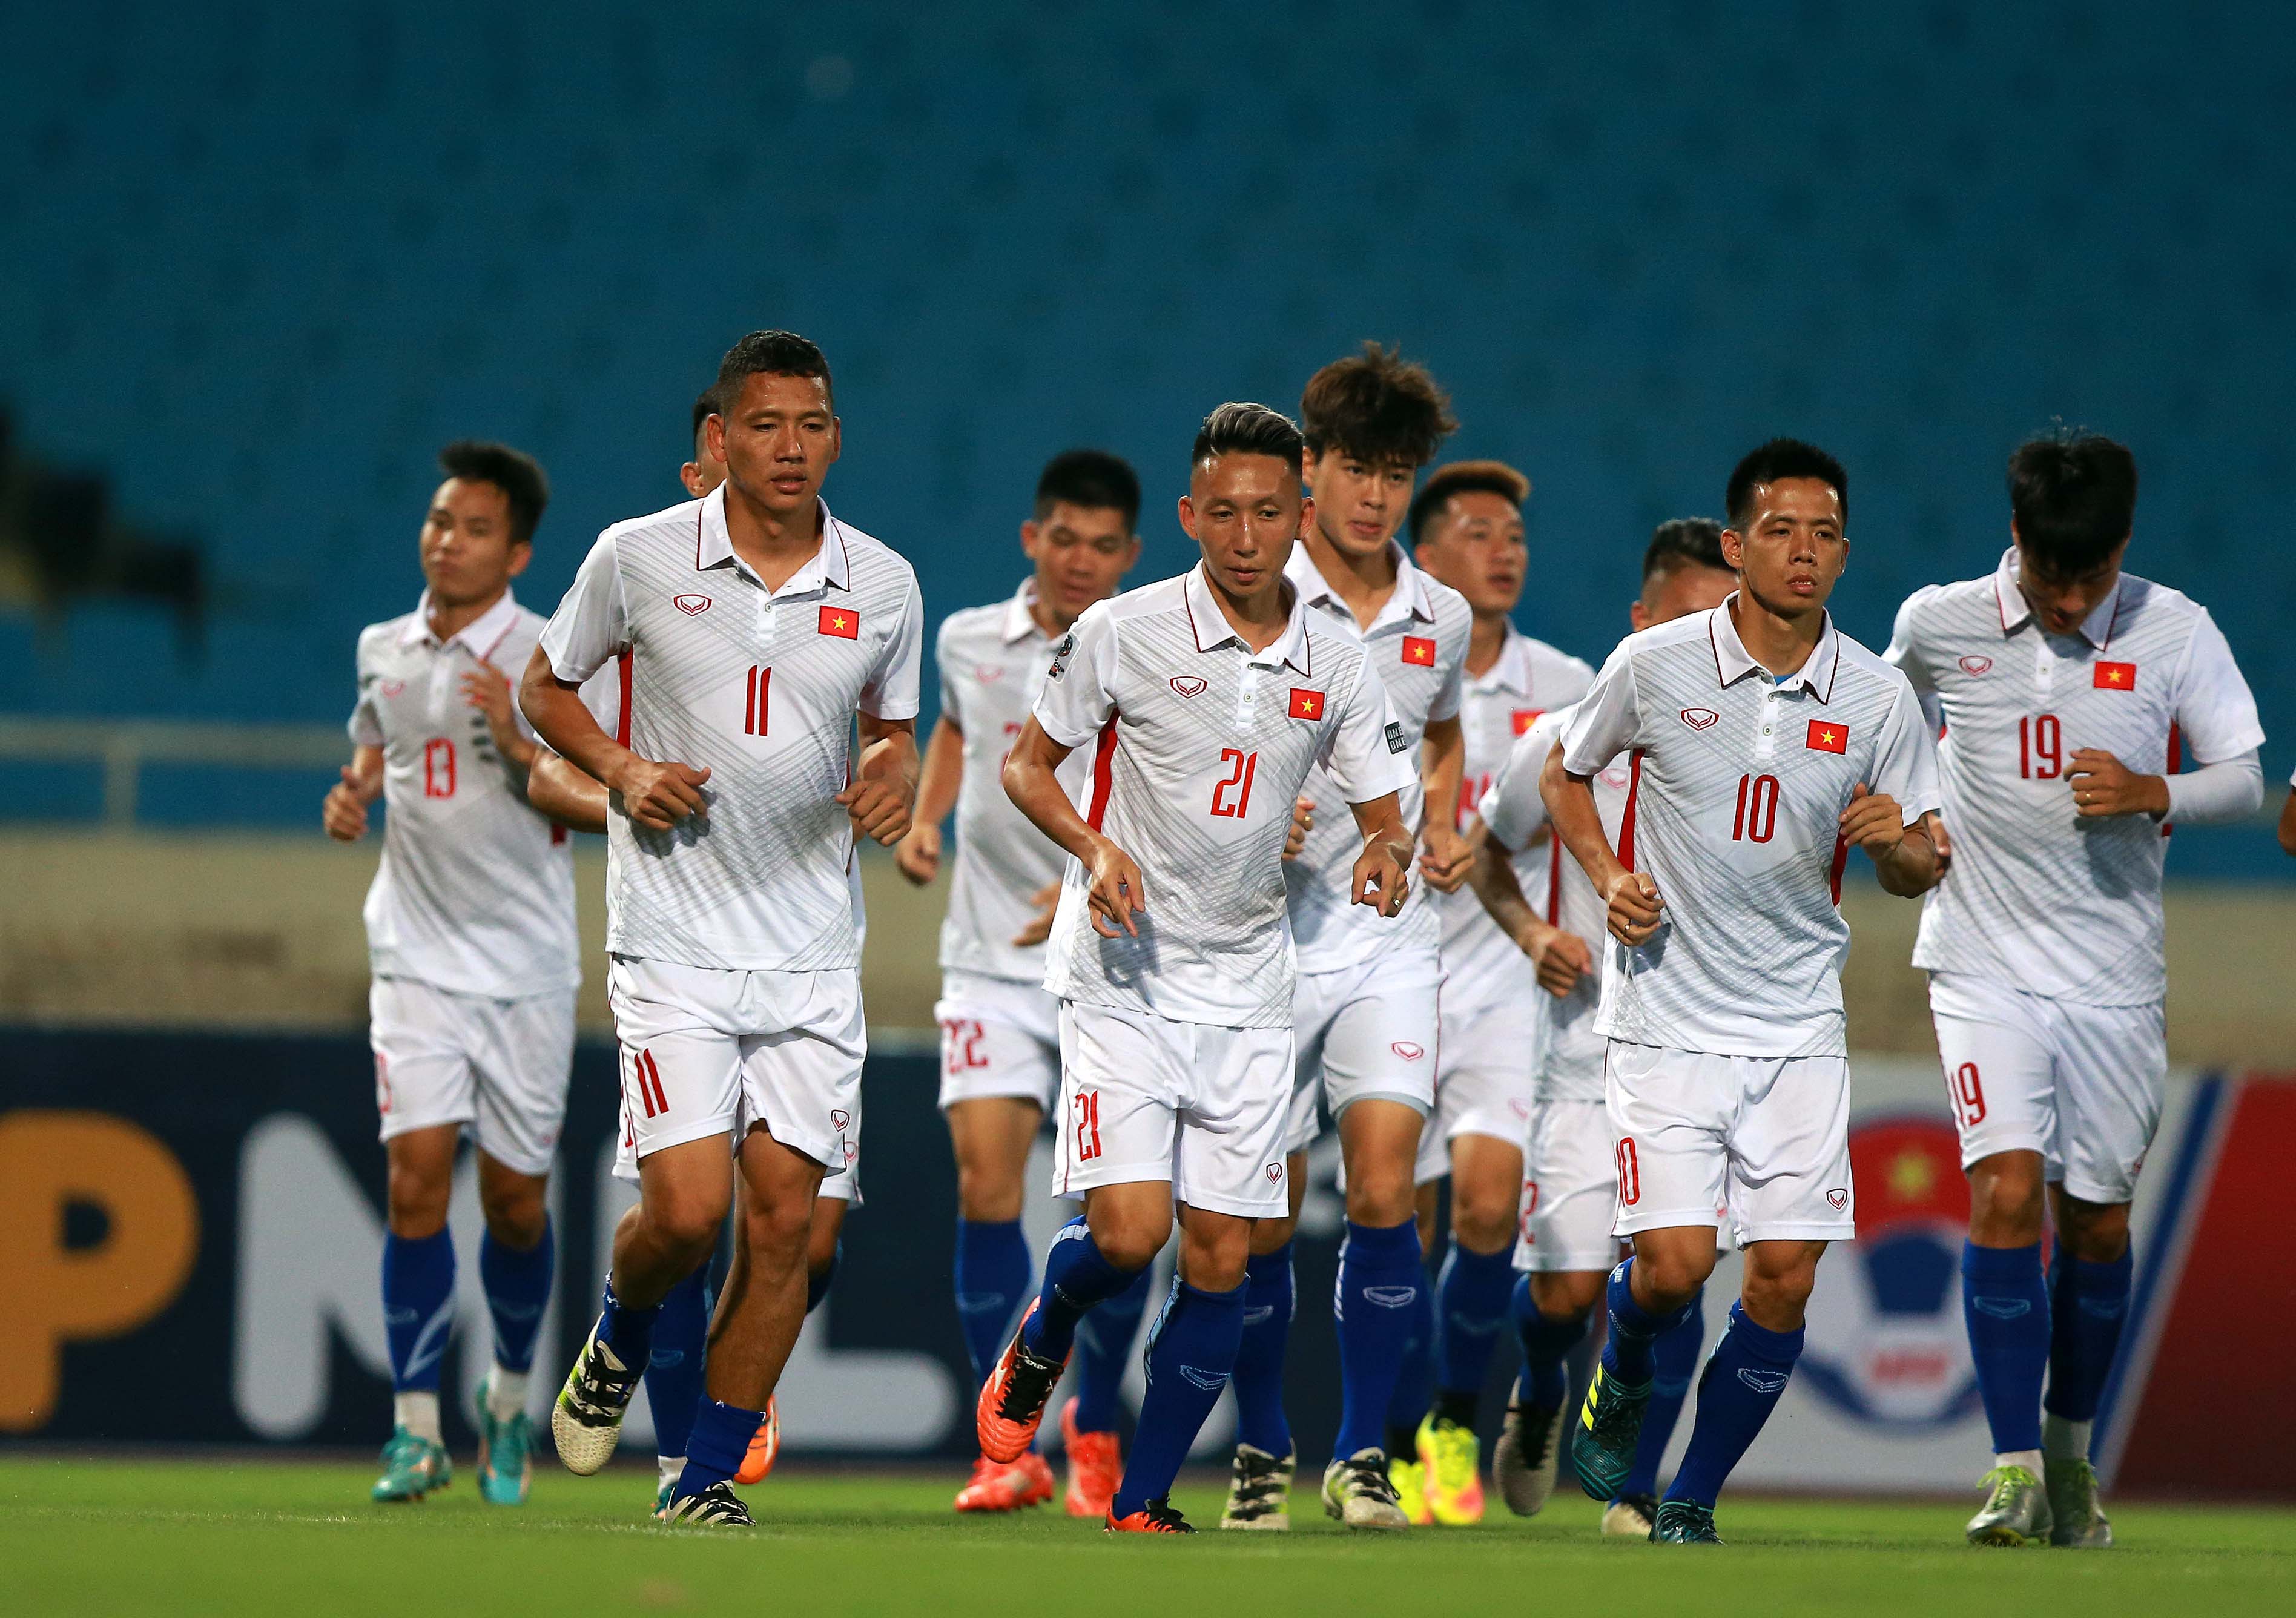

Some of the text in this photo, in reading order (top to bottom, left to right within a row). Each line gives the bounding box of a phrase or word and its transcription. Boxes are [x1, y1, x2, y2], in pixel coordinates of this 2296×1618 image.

[745, 665, 771, 736] 11
[1387, 727, 1404, 739] ONE
[424, 737, 458, 801] 13
[2019, 714, 2063, 779] 19
[1211, 748, 1258, 819] 21
[1734, 774, 1780, 844] 10
[635, 1048, 670, 1118] 11
[1951, 1062, 1987, 1131] 19
[1075, 1091, 1103, 1161] 21
[1616, 1137, 1641, 1207] 10
